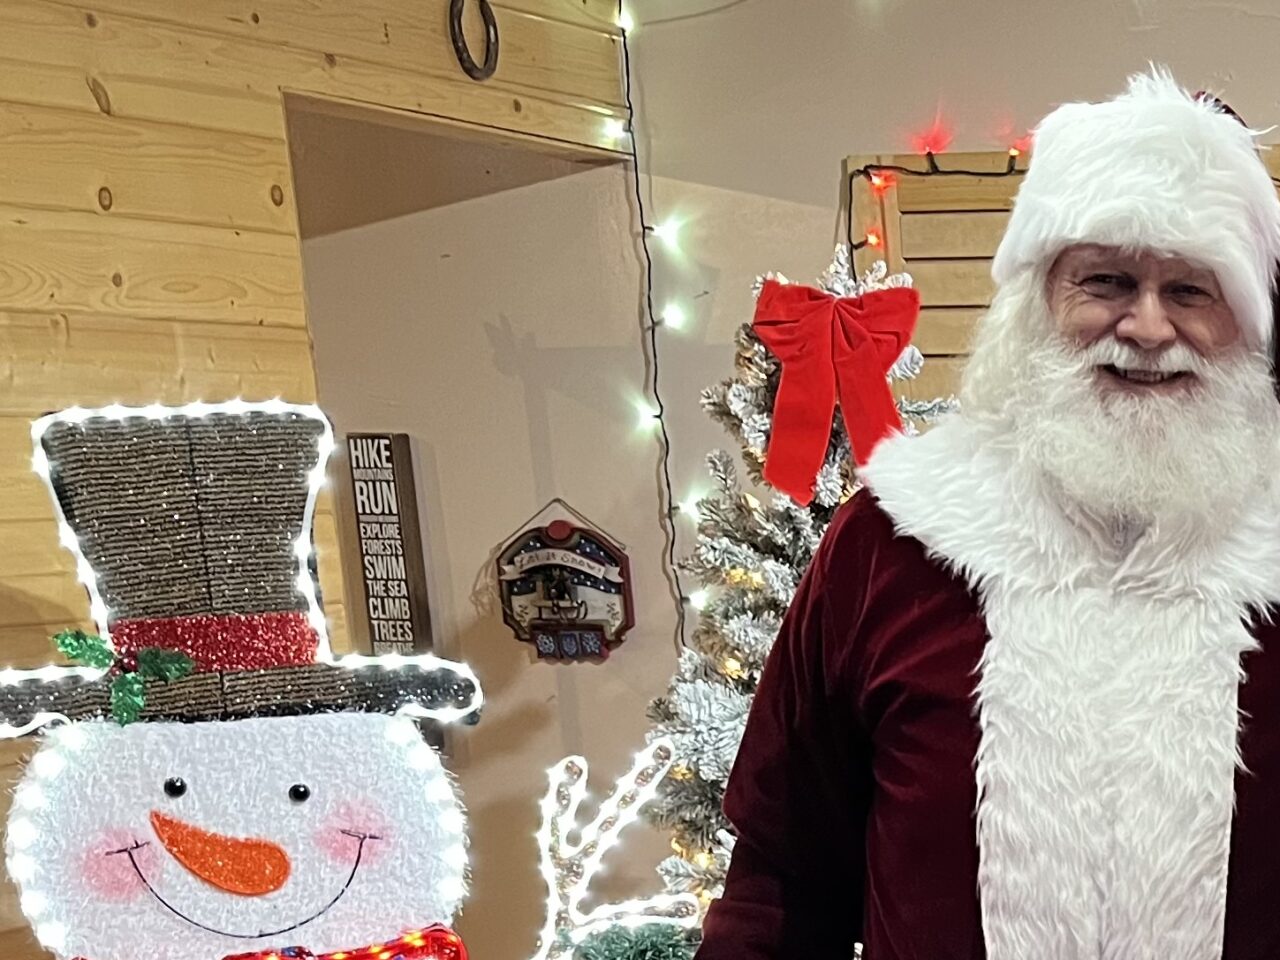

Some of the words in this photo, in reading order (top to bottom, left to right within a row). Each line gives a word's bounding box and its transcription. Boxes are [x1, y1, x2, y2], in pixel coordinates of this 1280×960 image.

[349, 438, 392, 468] HIKE
[354, 481, 398, 514] RUN
[360, 523, 401, 539] EXPLORE
[361, 539, 403, 555] FORESTS
[364, 555, 406, 579] SWIM
[366, 580, 387, 596] THE
[387, 580, 408, 597] SEA
[368, 597, 411, 619] CLIMB
[371, 620, 414, 641] TREES
